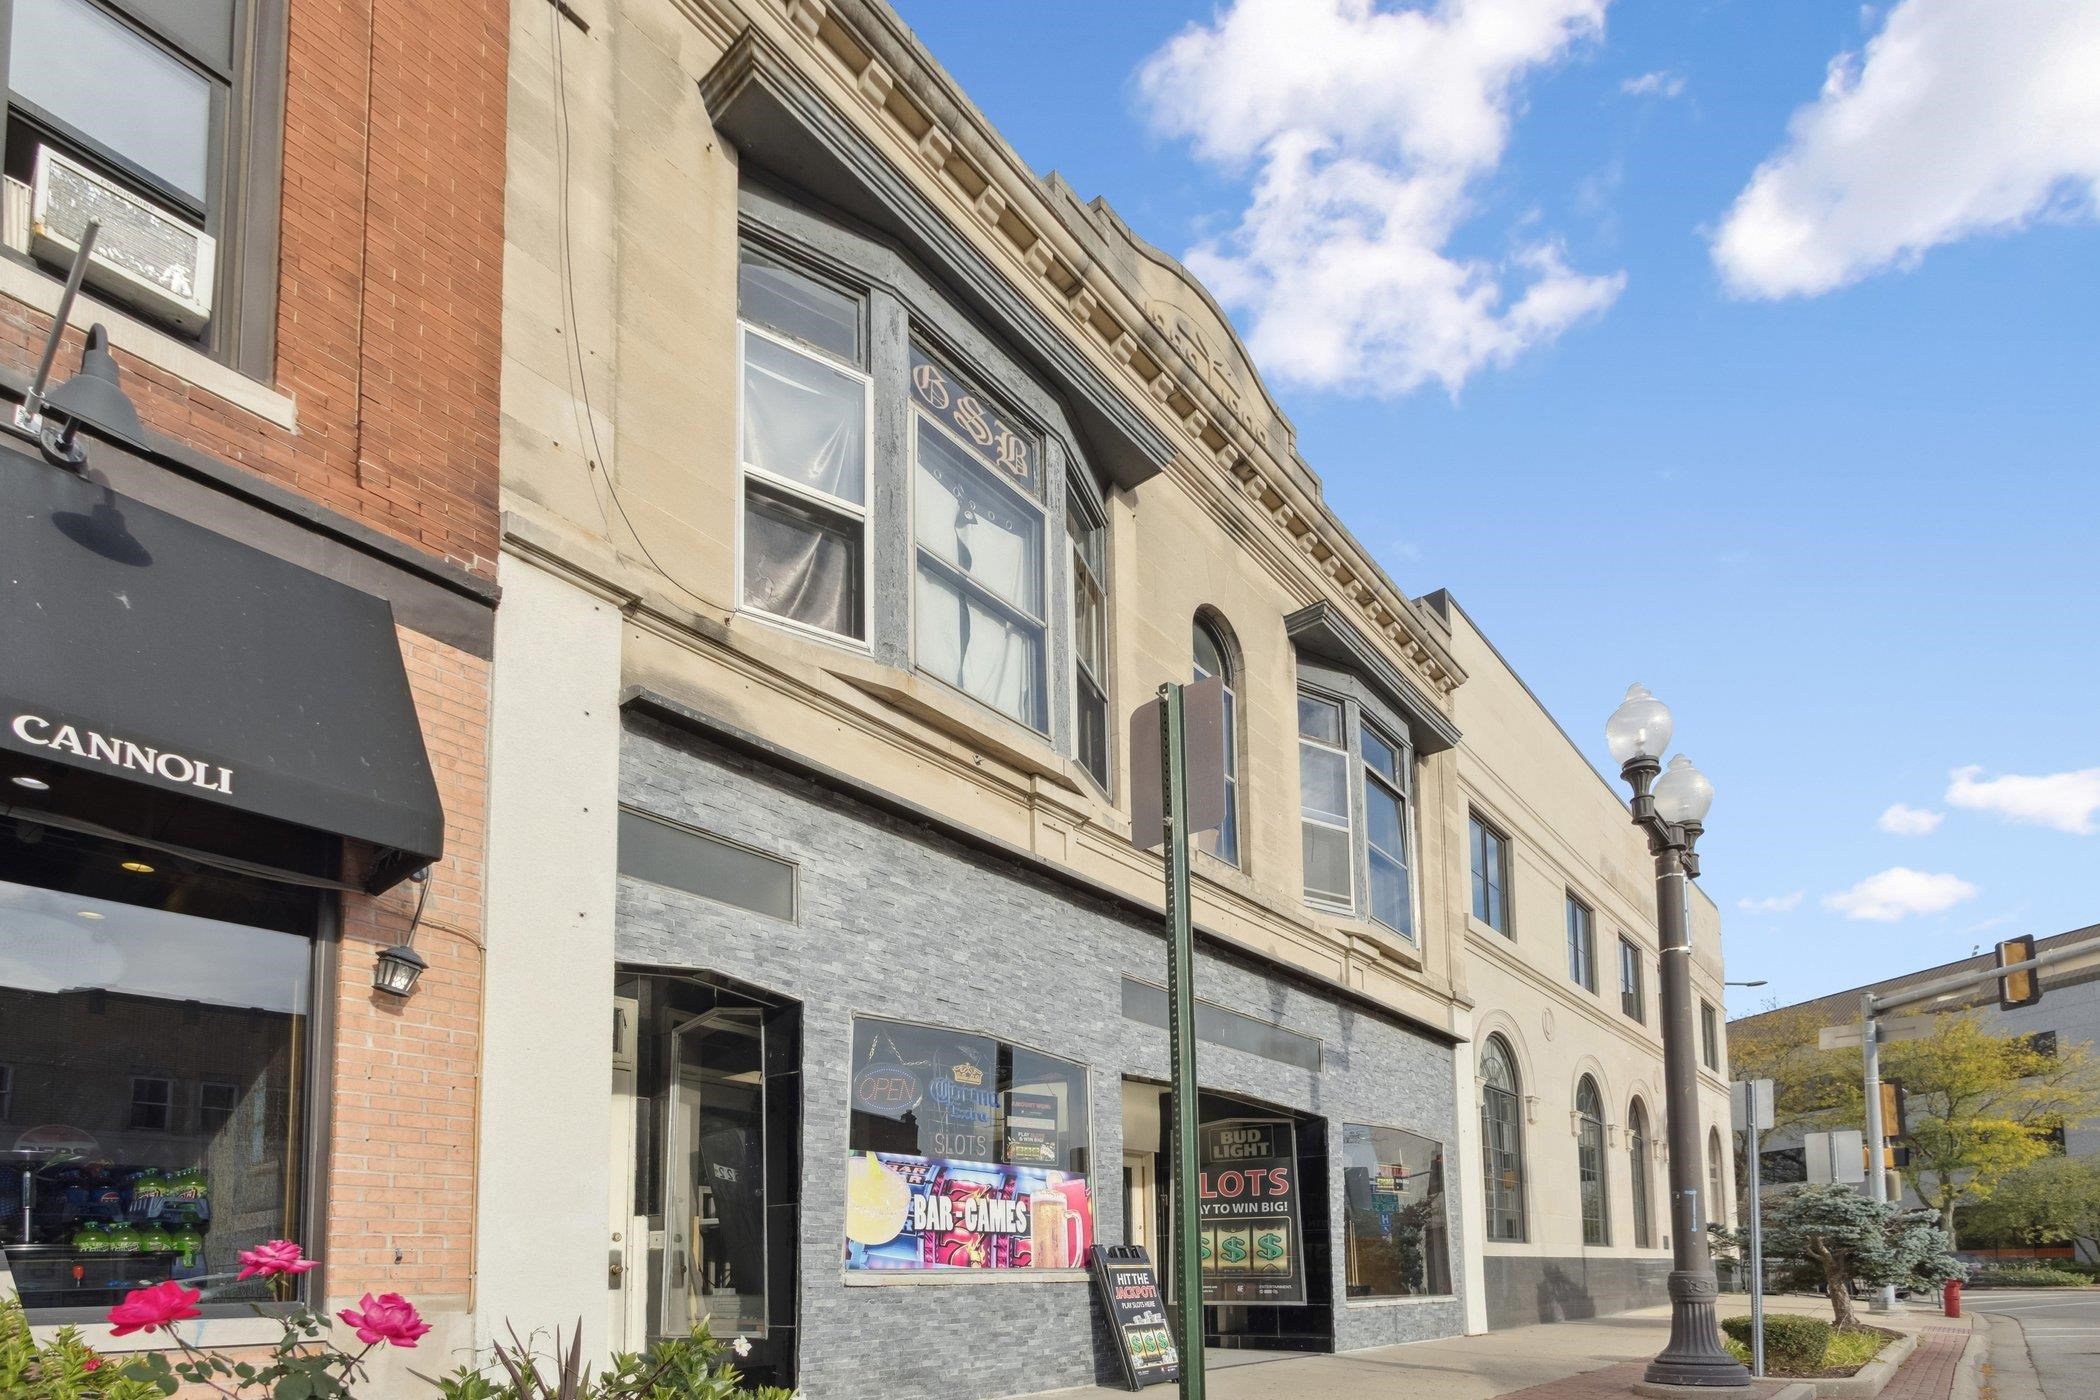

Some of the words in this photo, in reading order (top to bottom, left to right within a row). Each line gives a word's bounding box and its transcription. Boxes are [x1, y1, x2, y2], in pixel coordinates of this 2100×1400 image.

[12, 714, 234, 795] CANNOLI
[859, 1077, 916, 1101] OPEN
[934, 1132, 987, 1157] SLOTS
[1221, 1129, 1261, 1145] BUD
[1213, 1142, 1270, 1159] LIGHT
[1200, 1167, 1290, 1199] LOTS
[1213, 1203, 1230, 1213] TO
[1232, 1202, 1258, 1213] WIN
[1261, 1201, 1288, 1212] BIG!
[1116, 1273, 1131, 1286] HIT
[1131, 1272, 1150, 1285] THE
[1115, 1284, 1157, 1300] JACKPOT!
[1132, 1301, 1145, 1309] SLOTS
